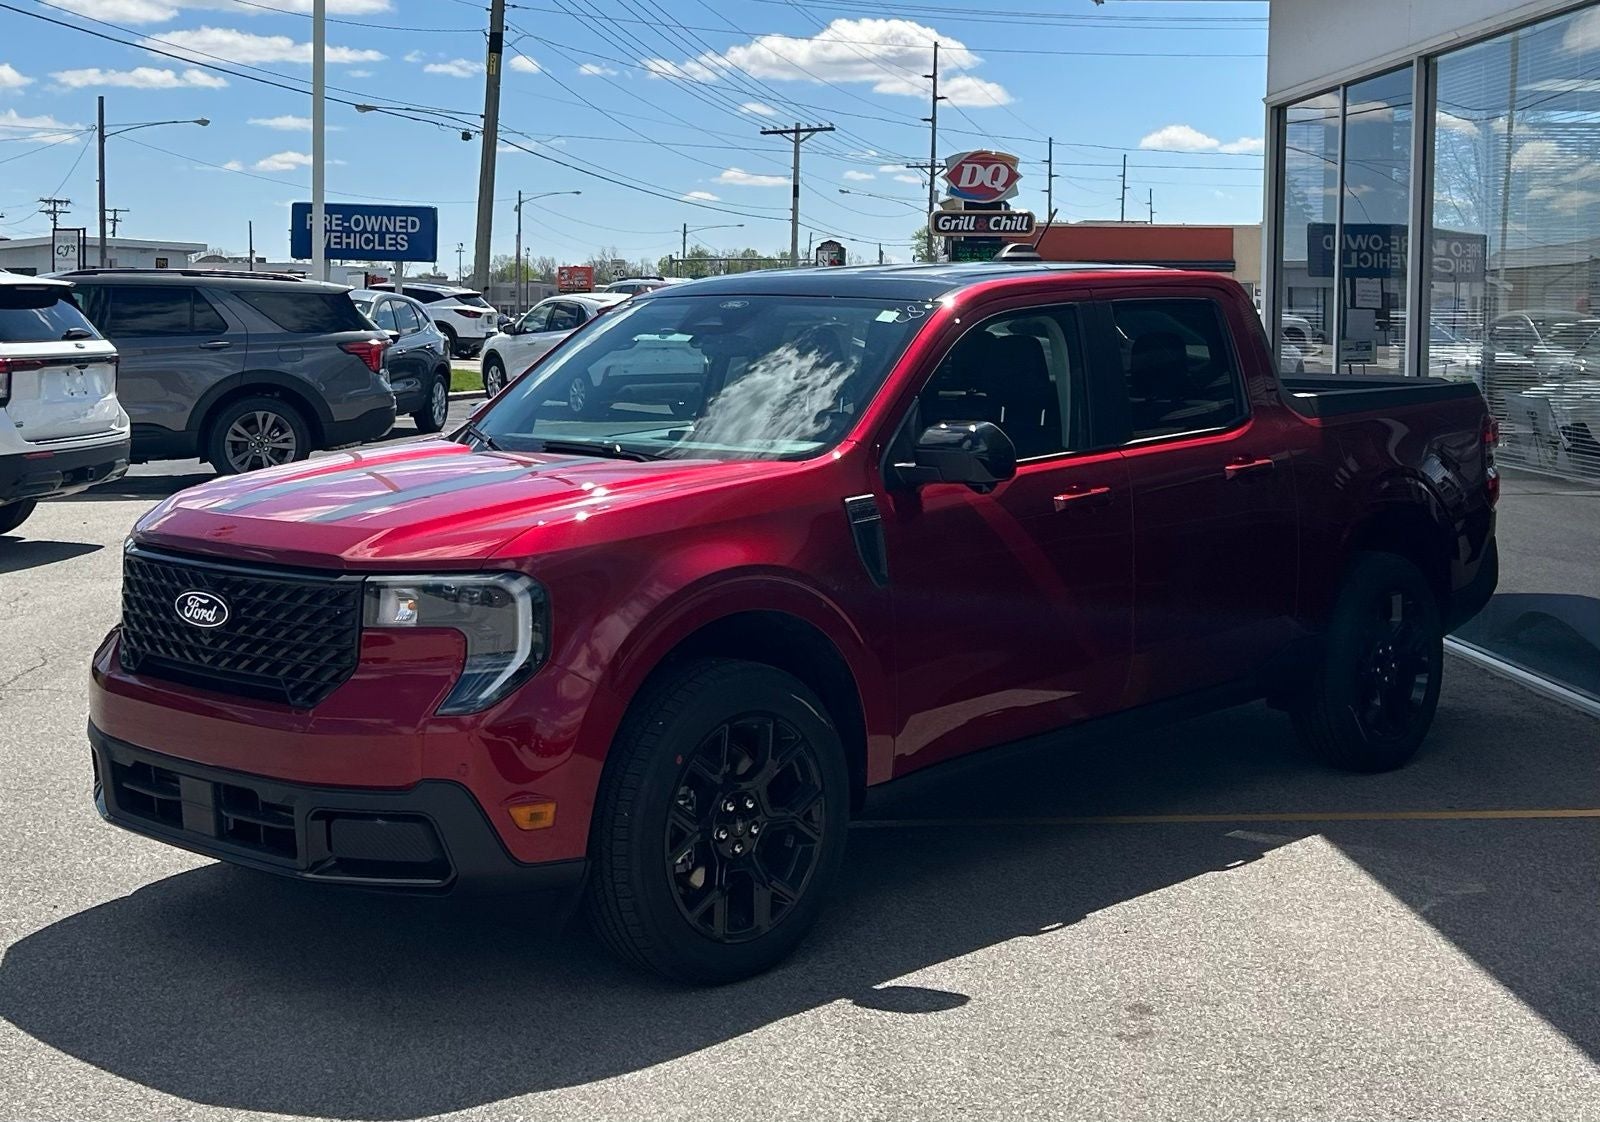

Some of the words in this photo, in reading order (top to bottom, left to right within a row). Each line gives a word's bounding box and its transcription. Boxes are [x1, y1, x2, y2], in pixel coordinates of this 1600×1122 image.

[958, 163, 1009, 192] DQ
[938, 215, 975, 231] Grill
[989, 215, 1029, 231] Chill
[613, 269, 625, 277] 40
[184, 595, 217, 622] Ford
